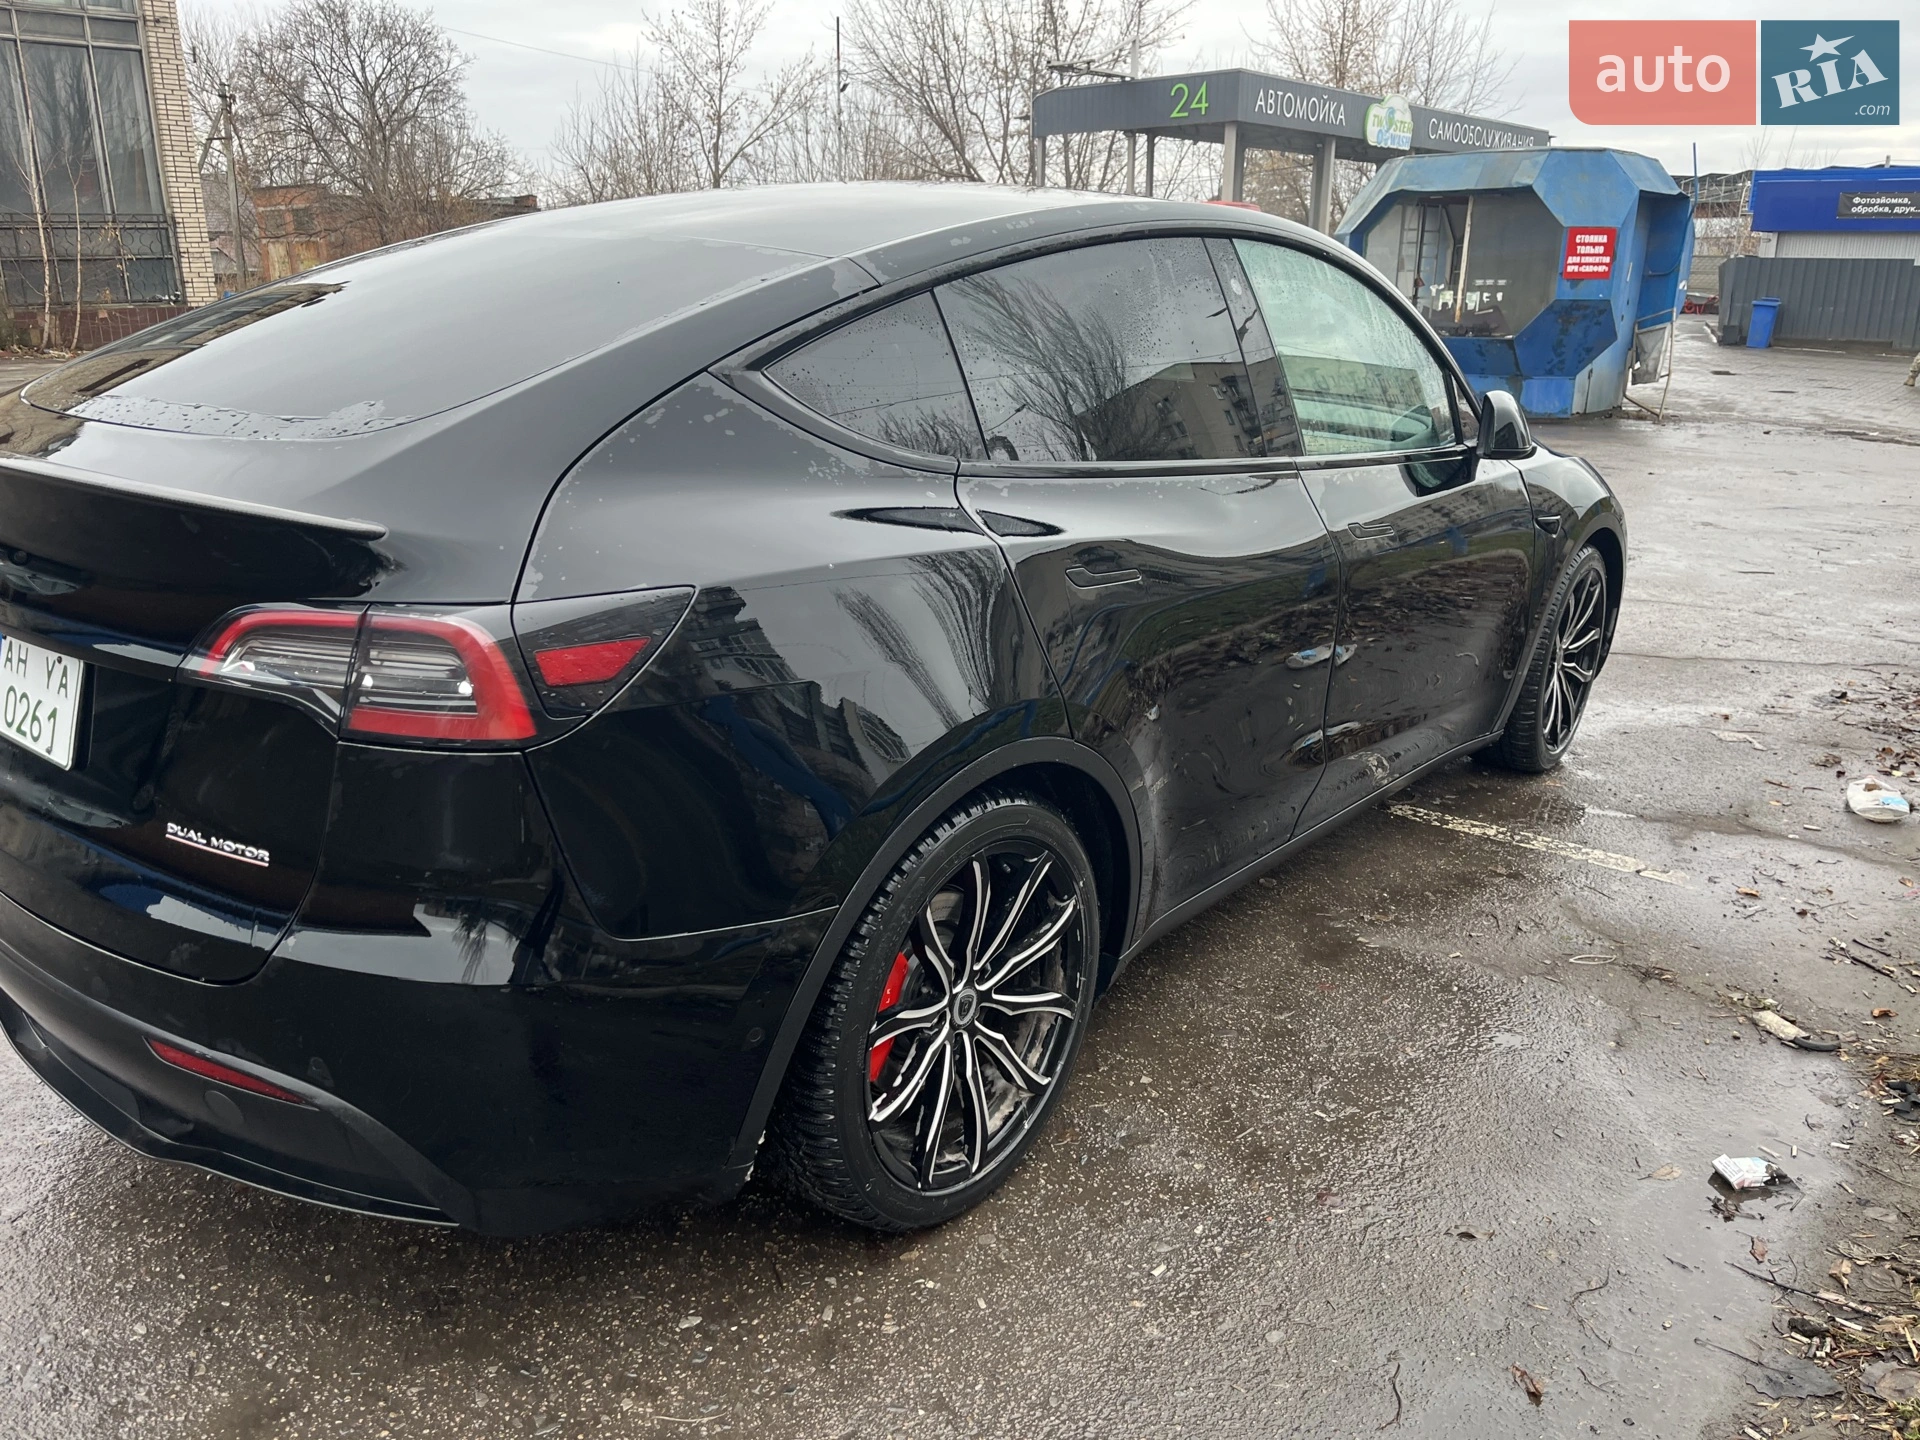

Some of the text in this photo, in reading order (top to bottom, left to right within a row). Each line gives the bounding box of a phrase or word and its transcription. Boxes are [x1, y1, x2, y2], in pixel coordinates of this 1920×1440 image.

[1170, 80, 1209, 118] 24
[1254, 88, 1346, 126] АВТОМОЙКА
[1851, 205, 1892, 214] обробка,
[1575, 234, 1608, 243] СТОЯНКА
[1576, 245, 1605, 254] ТОЛЬКО
[4, 640, 69, 699] AH YA
[4, 685, 58, 755] 0261
[166, 822, 270, 862] DUAL MOTOR
